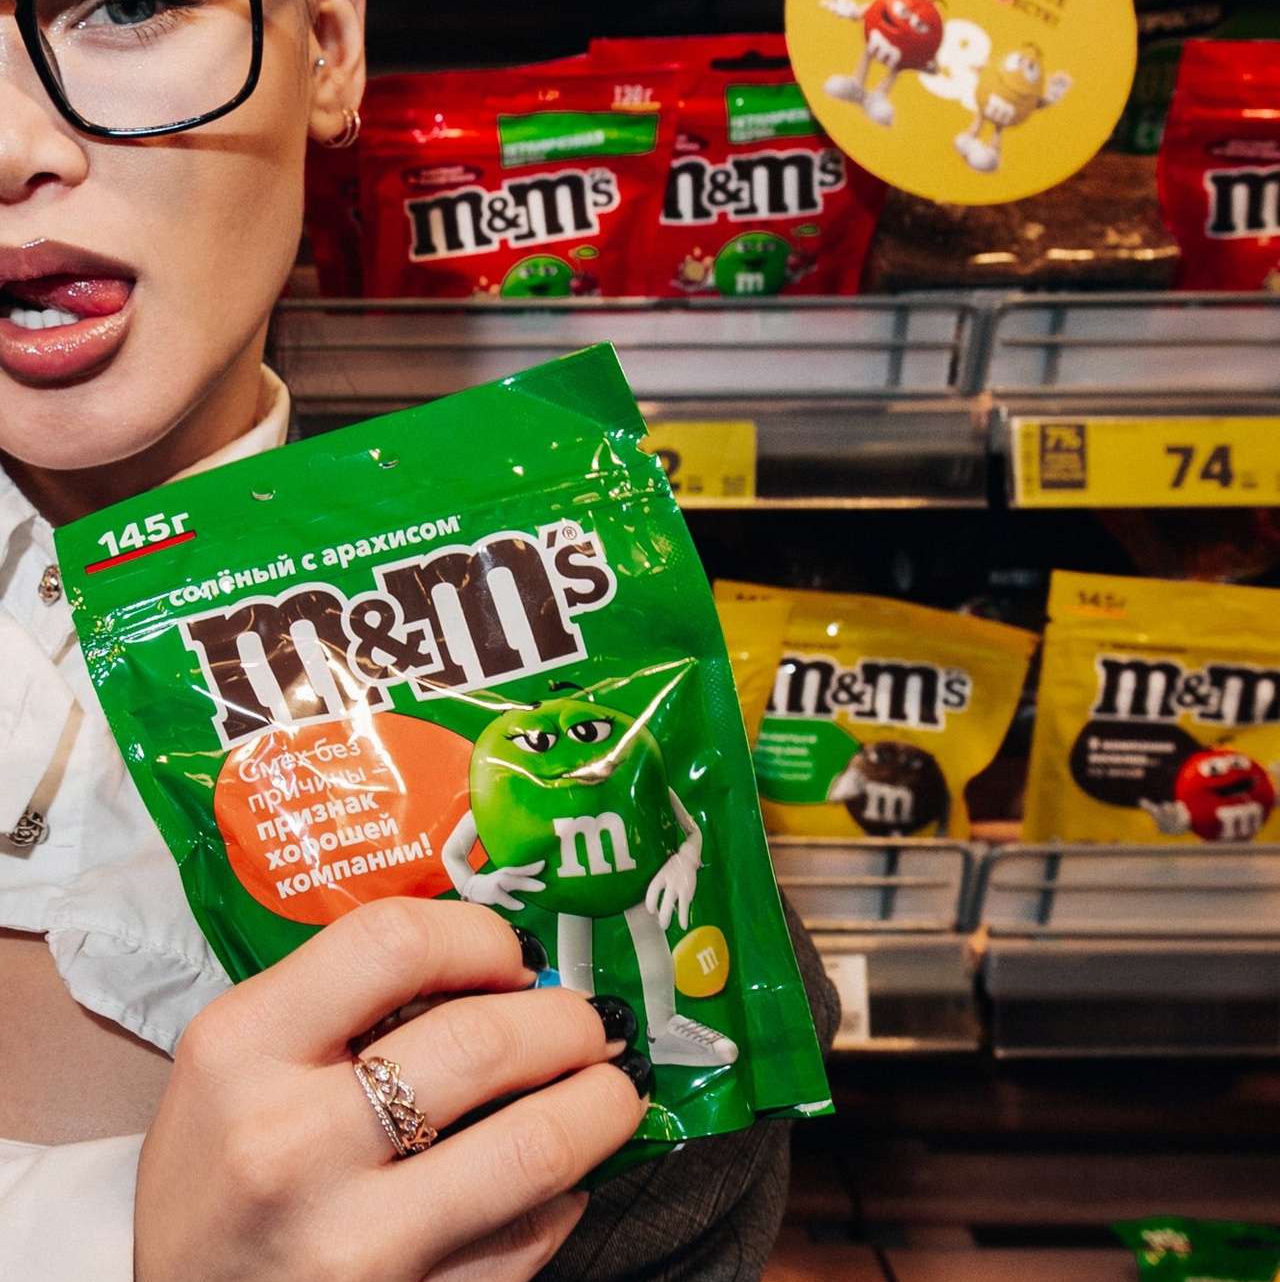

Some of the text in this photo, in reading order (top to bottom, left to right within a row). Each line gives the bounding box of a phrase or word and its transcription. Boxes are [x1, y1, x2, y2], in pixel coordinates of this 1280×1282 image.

[1165, 444, 1234, 489] 74
[97, 511, 191, 558] 145г
[169, 554, 296, 607] солёный
[320, 514, 461, 569] арахисом
[237, 737, 363, 784] Смех без
[255, 791, 381, 843] признак
[865, 784, 915, 823] m
[264, 812, 400, 871] хорошей
[275, 832, 435, 900] компании!
[552, 811, 638, 879] m
[696, 945, 721, 976] m
